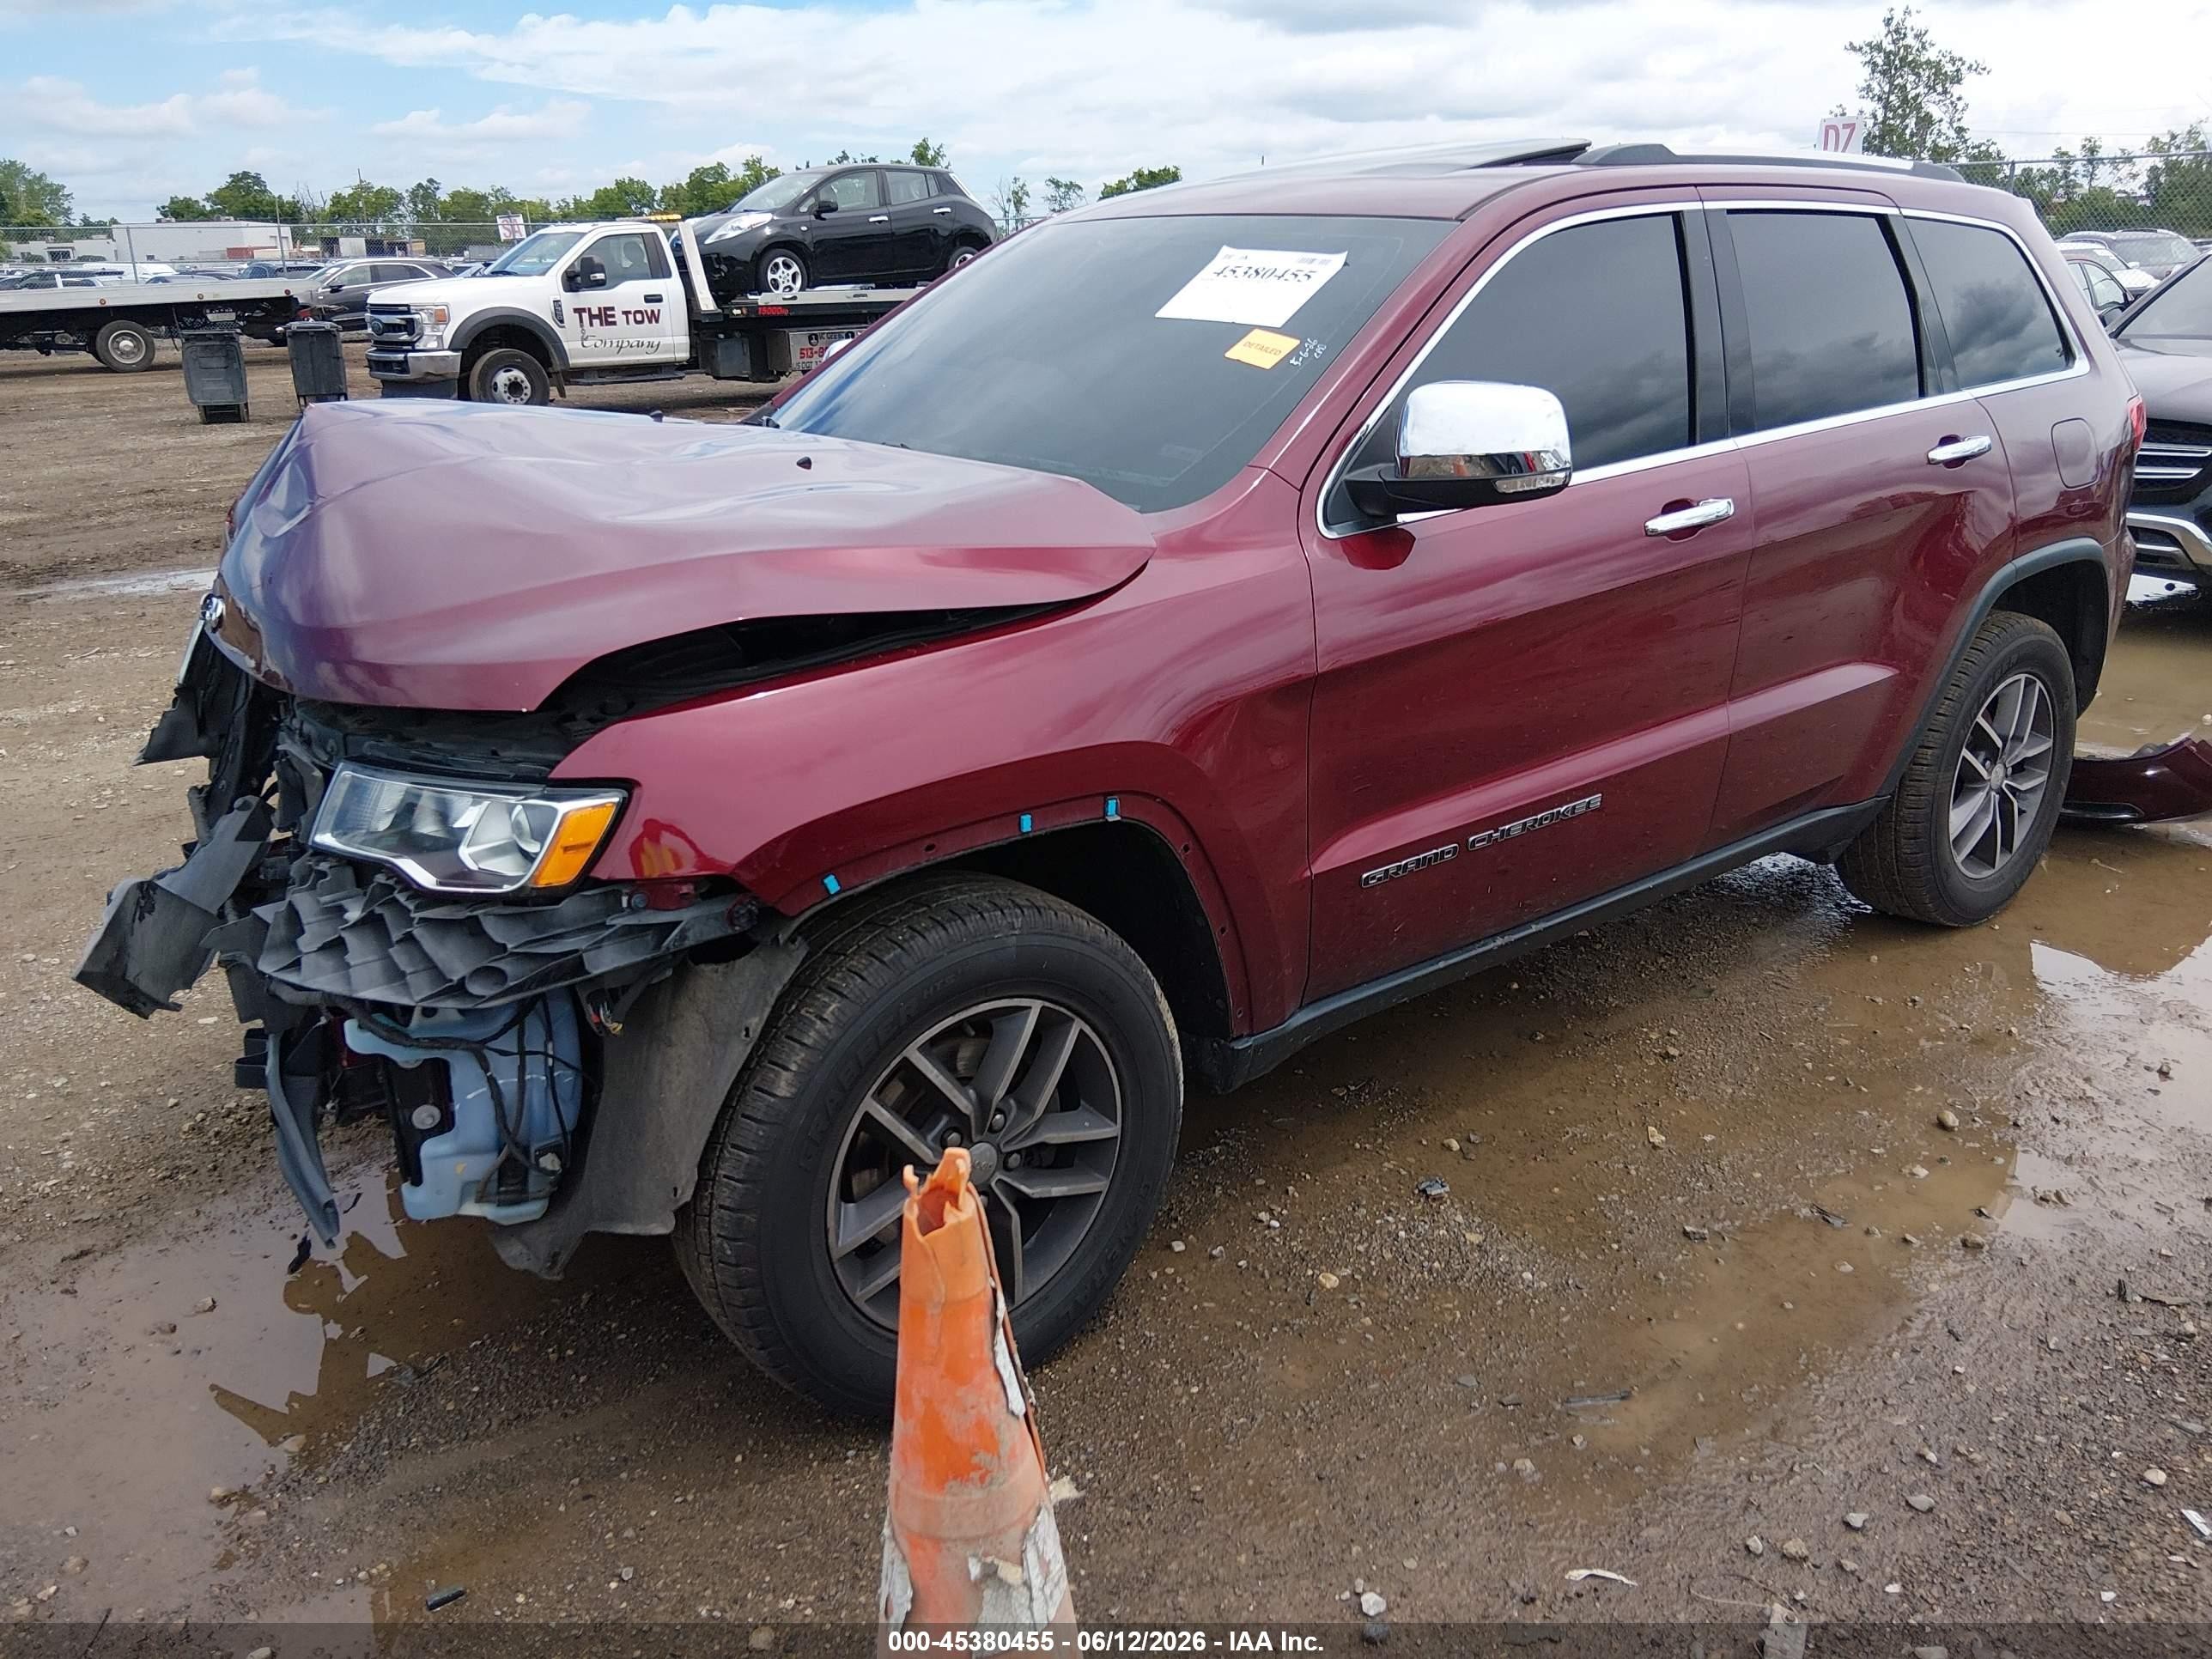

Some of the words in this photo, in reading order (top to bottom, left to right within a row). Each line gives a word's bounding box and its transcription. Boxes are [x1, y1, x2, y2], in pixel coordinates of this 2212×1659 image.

[1212, 264, 1318, 283] 45380455
[572, 306, 617, 327] THE
[621, 308, 660, 325] TOW
[580, 334, 661, 355] Company
[1243, 340, 1282, 356] DETAILED
[1361, 842, 1460, 889] GRAND
[1467, 793, 1602, 851] CHEROKEE
